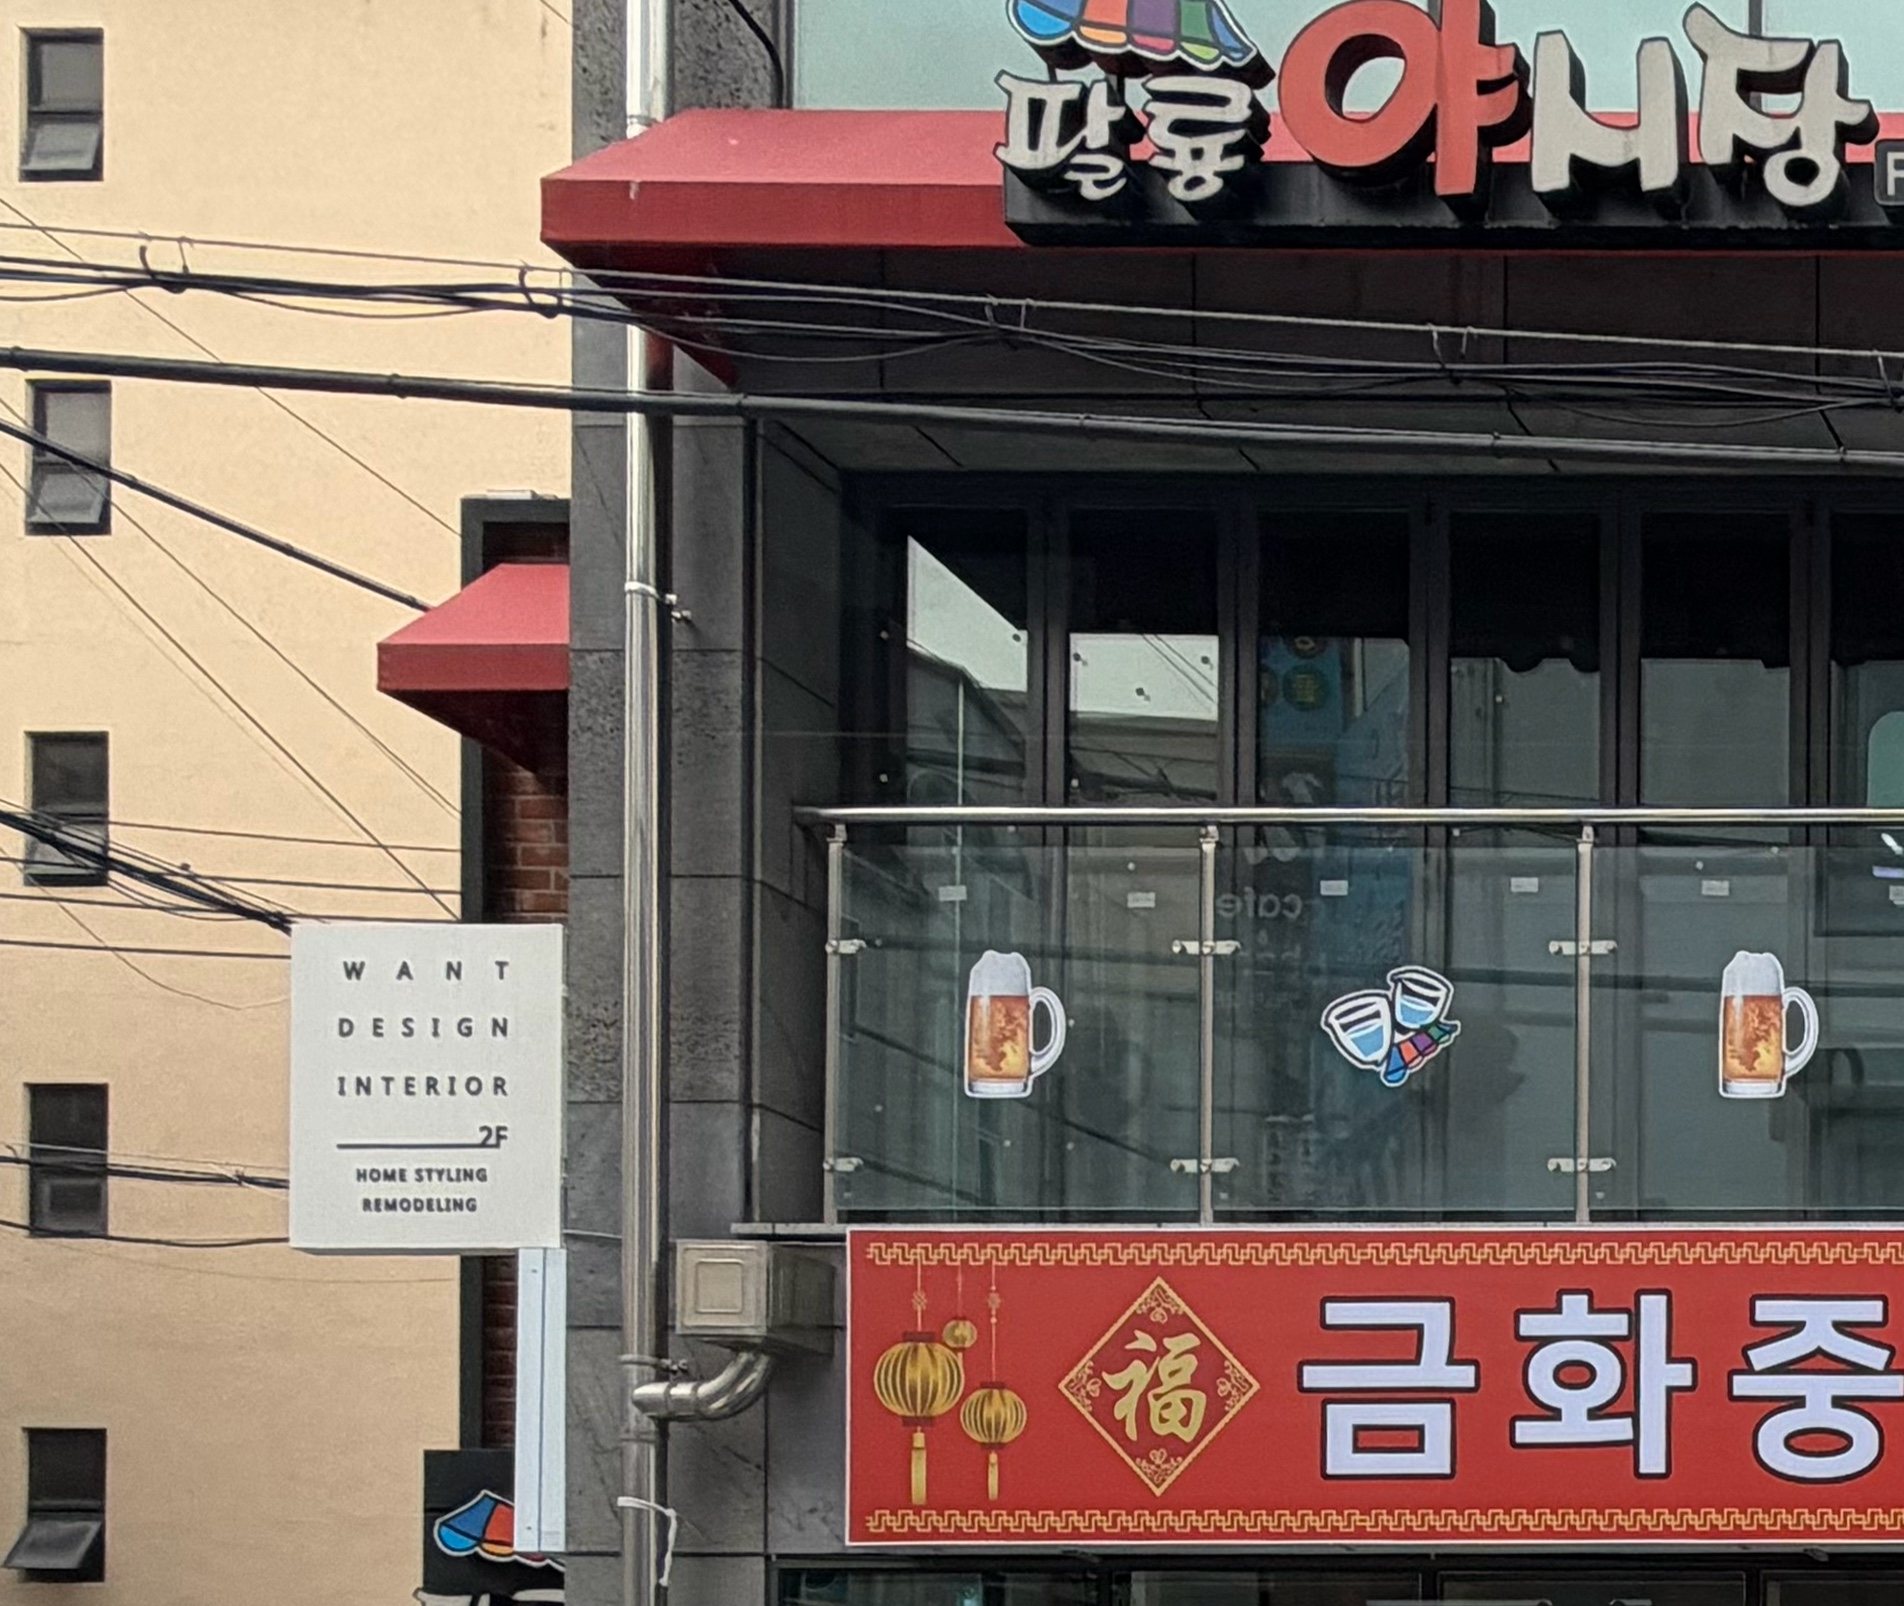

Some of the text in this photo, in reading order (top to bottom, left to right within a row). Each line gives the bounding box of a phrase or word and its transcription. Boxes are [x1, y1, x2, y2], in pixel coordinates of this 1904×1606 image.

[995, 70, 1260, 201] 팔룡
[342, 960, 510, 981] WANT
[337, 1017, 509, 1038] DESIGN
[337, 1075, 509, 1097] INTERIOR
[478, 1125, 509, 1148] 2F
[356, 1167, 488, 1183] HOME STYLING
[362, 1197, 478, 1213] REMODELING
[1102, 1329, 1208, 1443] 福
